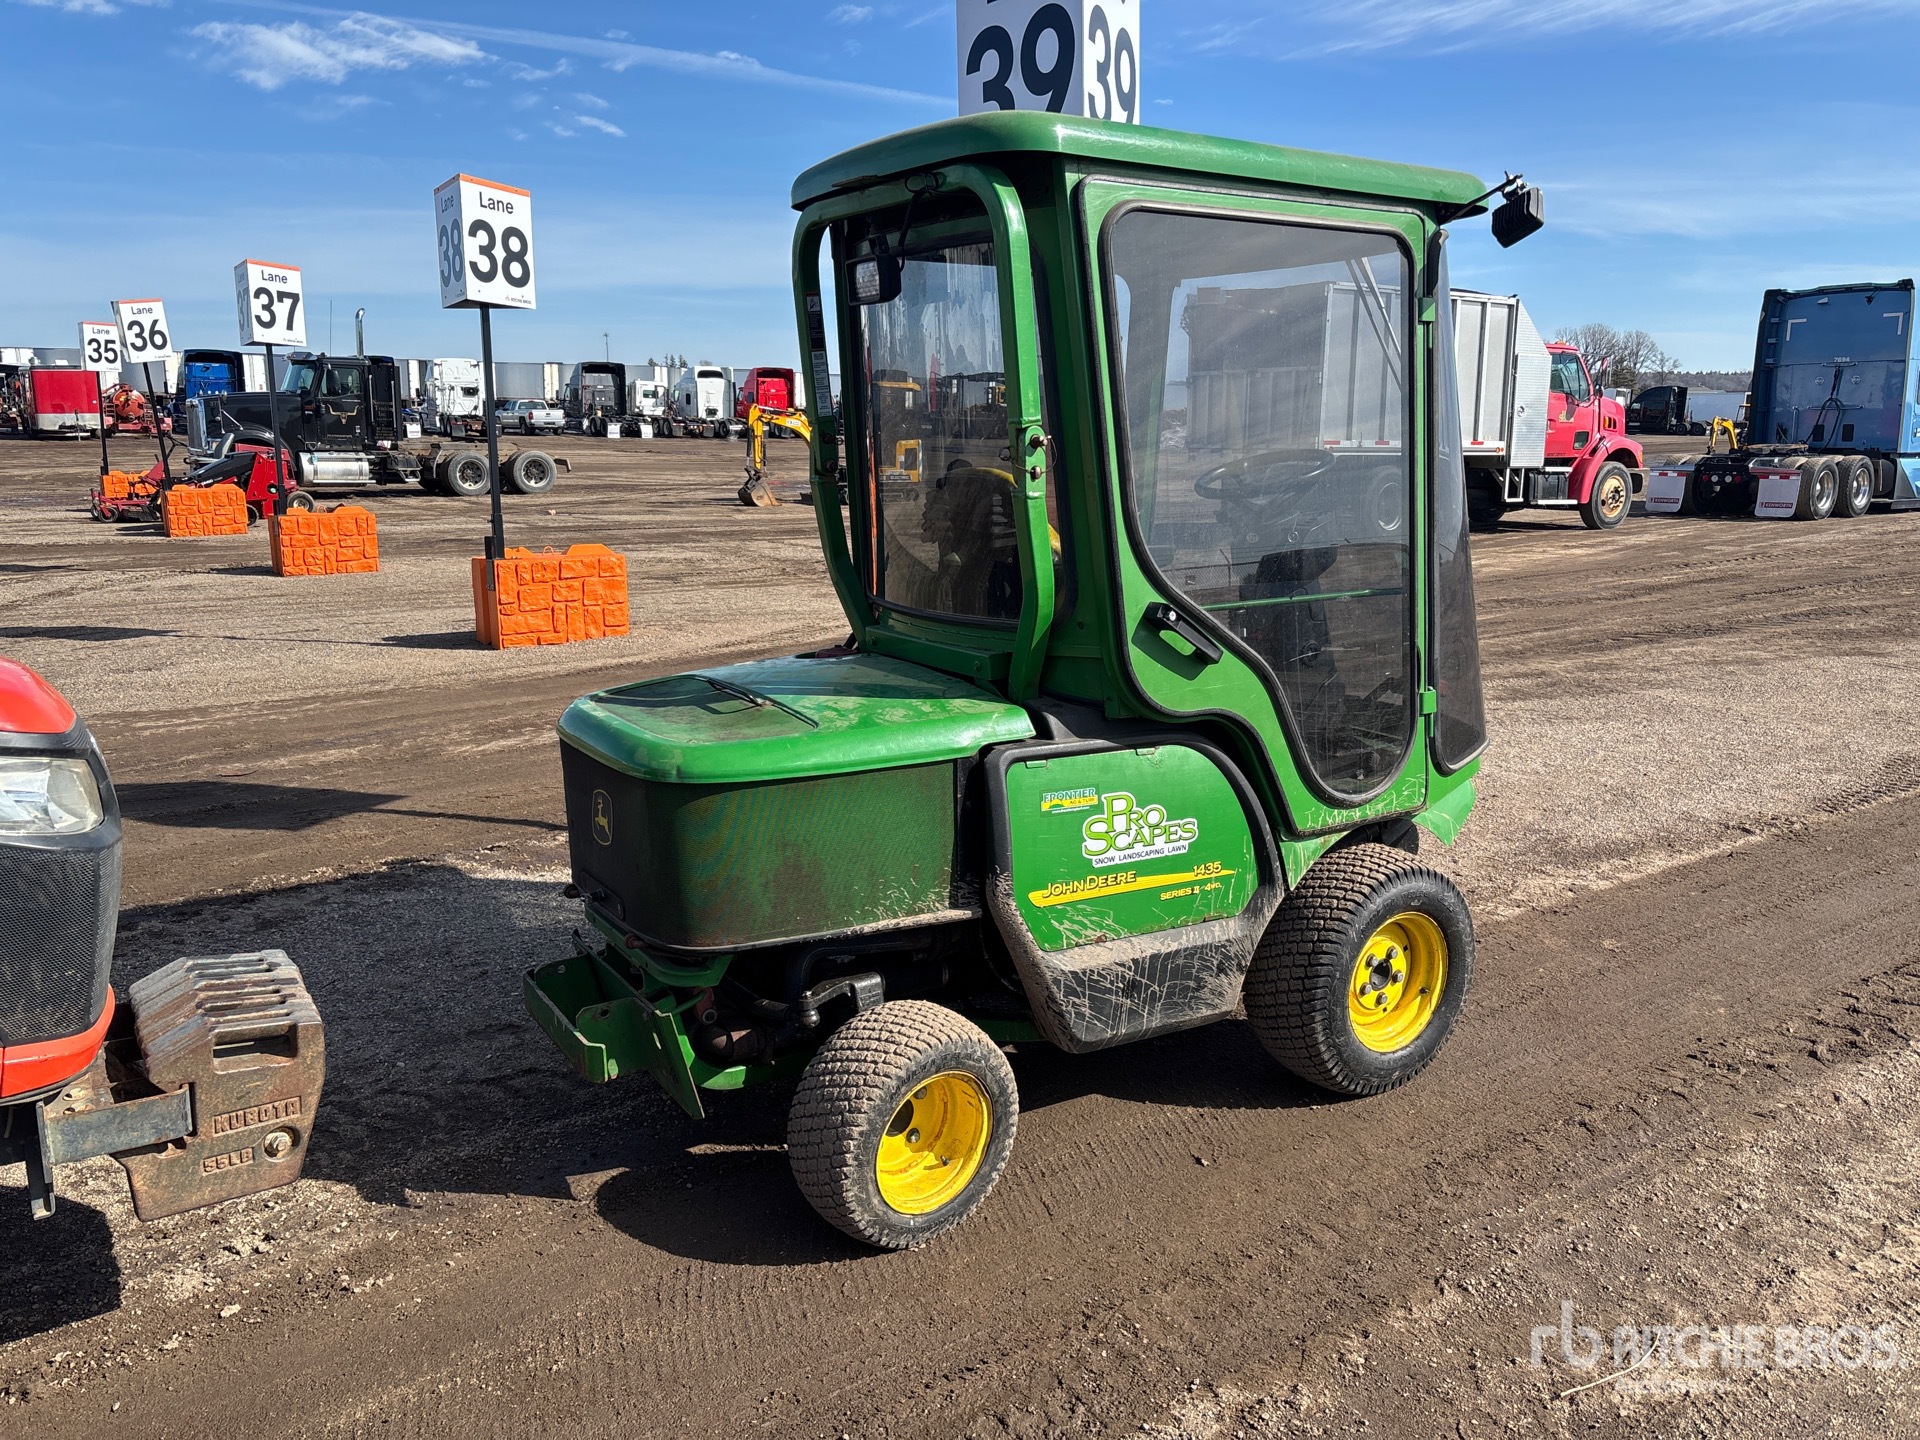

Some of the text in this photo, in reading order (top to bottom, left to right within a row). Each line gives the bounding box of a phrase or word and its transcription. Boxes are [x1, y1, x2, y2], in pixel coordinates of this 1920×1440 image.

[966, 3, 1075, 113] 39
[1088, 4, 1136, 124] 39
[441, 195, 455, 213] Lane
[479, 191, 514, 214] Lane
[440, 218, 463, 287] 38
[468, 219, 531, 288] 38
[261, 269, 288, 284] Lane
[131, 306, 153, 315] Lane
[237, 286, 250, 331] 37
[253, 286, 300, 331] 37
[92, 327, 110, 335] Lane
[127, 319, 168, 352] 36
[87, 338, 118, 364] 35
[1043, 787, 1095, 803] FRONTIER
[1094, 844, 1187, 866] SNOW LANDSCAPING LAWN
[1042, 861, 1222, 898] JOHN DEERE 1435
[1160, 887, 1192, 900] SERIES
[213, 1097, 302, 1135] KUBOTA
